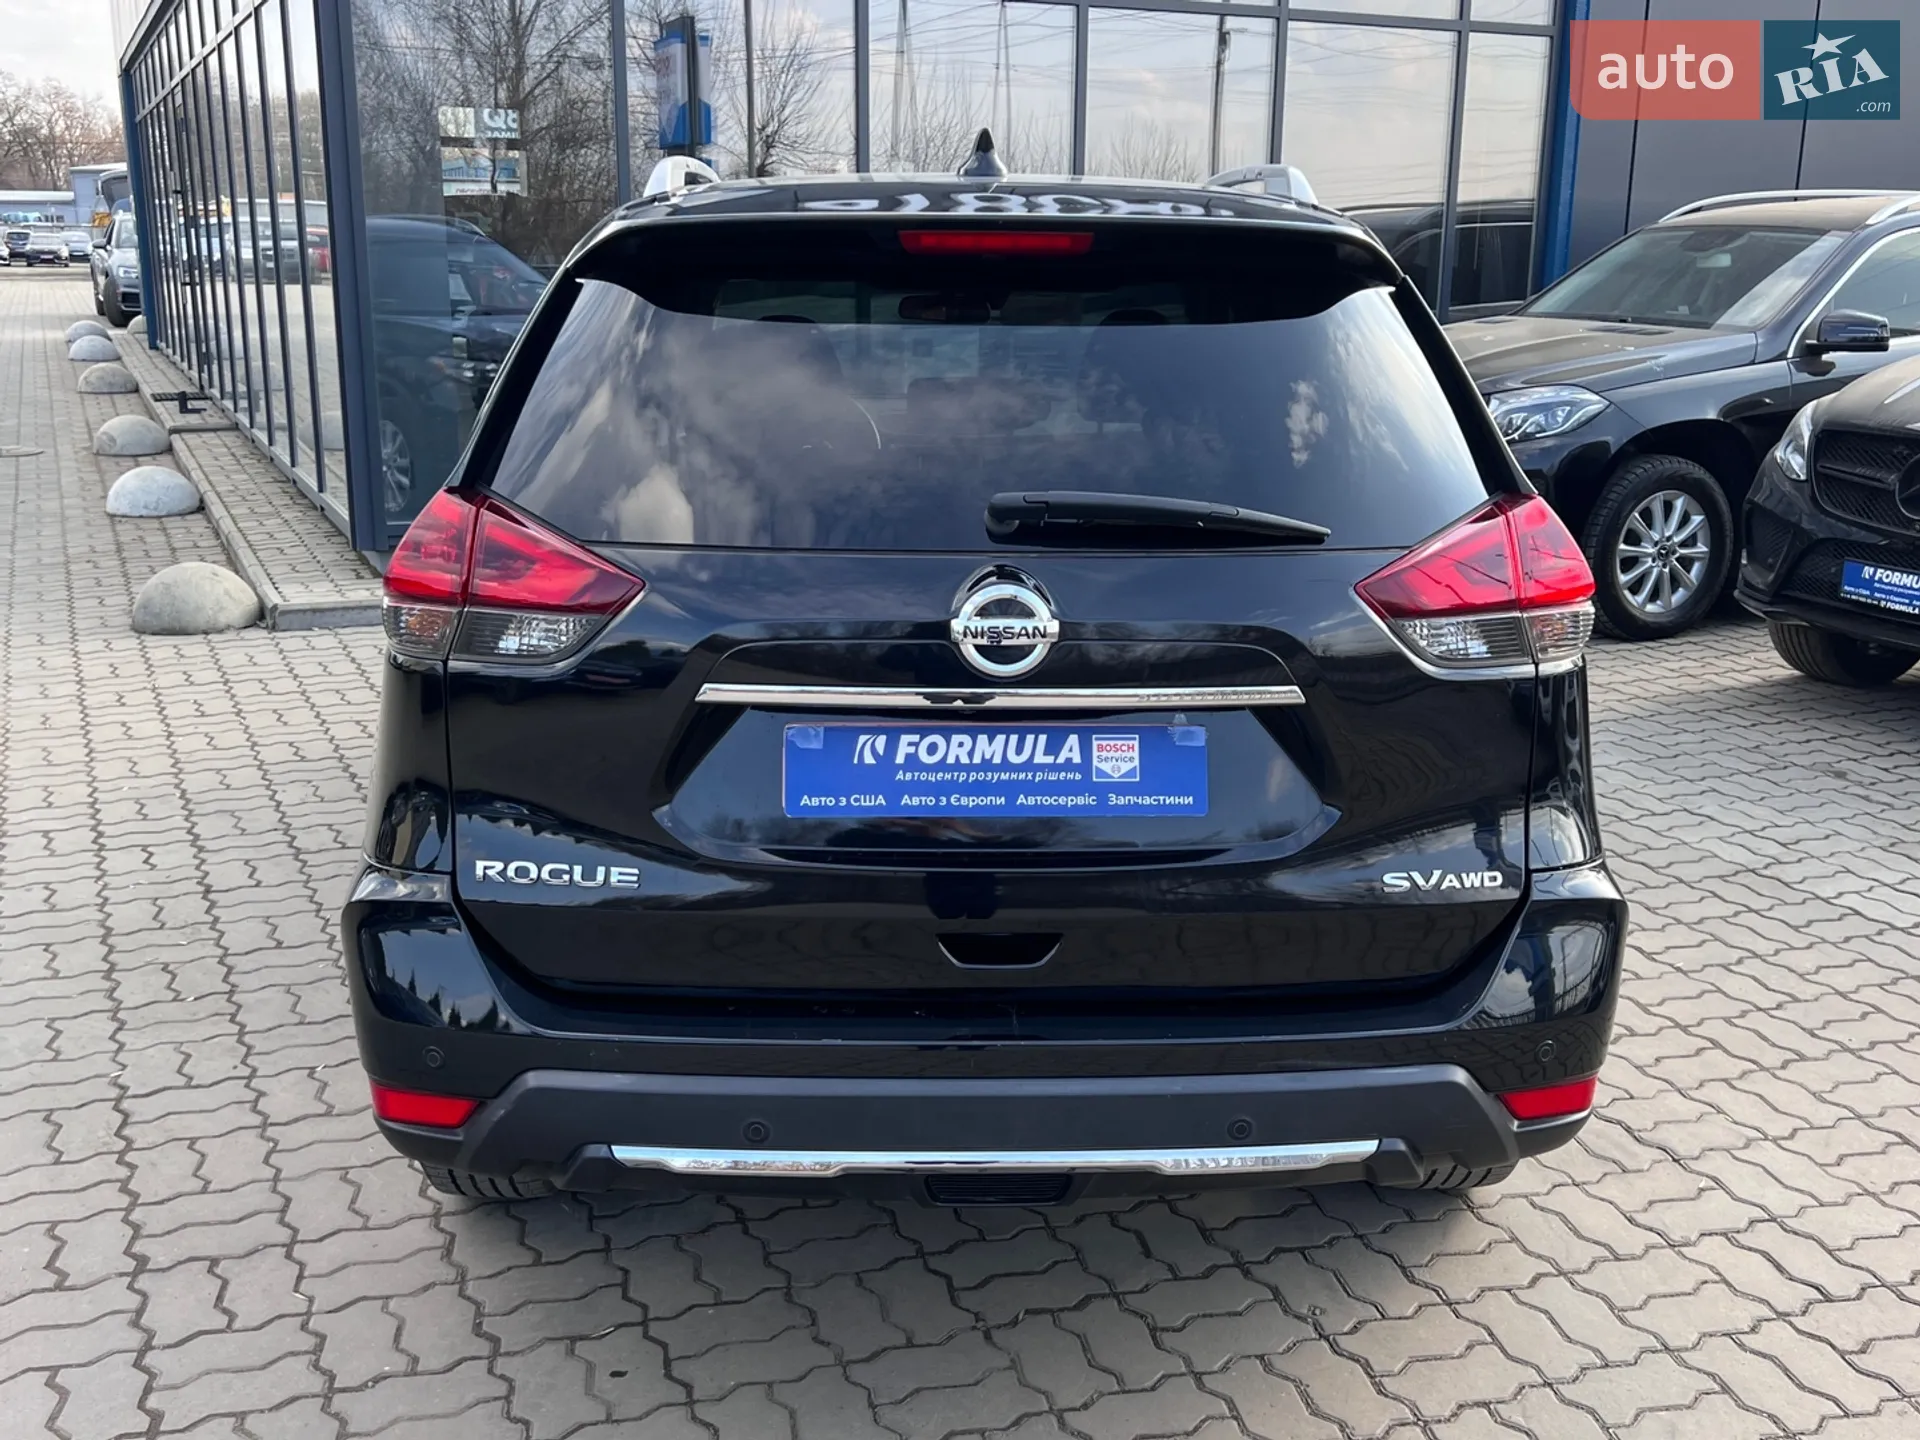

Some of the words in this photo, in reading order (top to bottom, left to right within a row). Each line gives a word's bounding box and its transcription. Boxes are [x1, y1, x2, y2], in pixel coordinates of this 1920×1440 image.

[962, 625, 1047, 640] NISSAN
[895, 734, 1082, 764] FORMULA
[1096, 743, 1135, 754] BOSCH
[1096, 755, 1135, 764] Service
[895, 770, 967, 783] Автоцентр
[968, 771, 1034, 783] розумних
[1035, 769, 1083, 783] рішень
[800, 795, 836, 806] Авто
[838, 797, 847, 806] з
[850, 794, 887, 806] США
[901, 794, 936, 806] Авто
[938, 796, 947, 805] з
[950, 794, 1006, 808] Європи
[1016, 793, 1098, 808] Автосервіс
[1107, 793, 1194, 805] Запчастини
[475, 860, 641, 889] ROGUE
